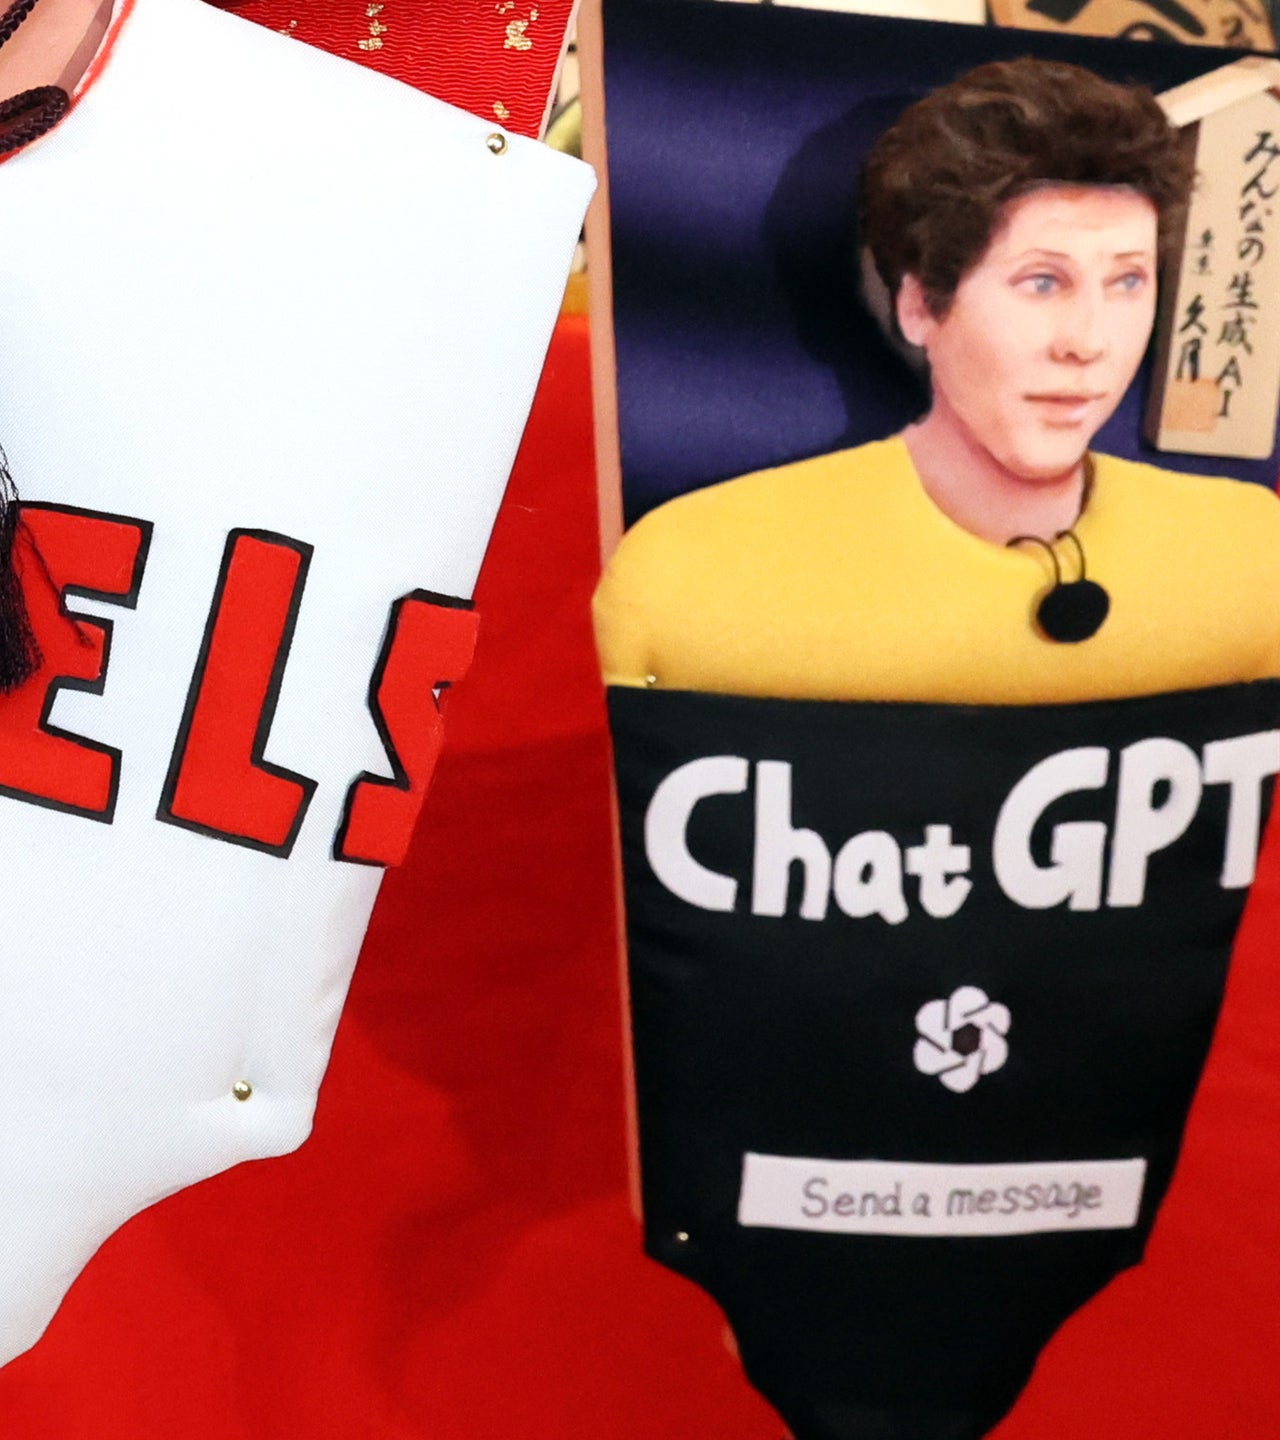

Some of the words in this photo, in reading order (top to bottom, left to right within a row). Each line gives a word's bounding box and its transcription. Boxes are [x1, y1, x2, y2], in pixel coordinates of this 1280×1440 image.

[801, 1176, 903, 1219] Send
[911, 1192, 933, 1218] a
[945, 1181, 1103, 1219] message
